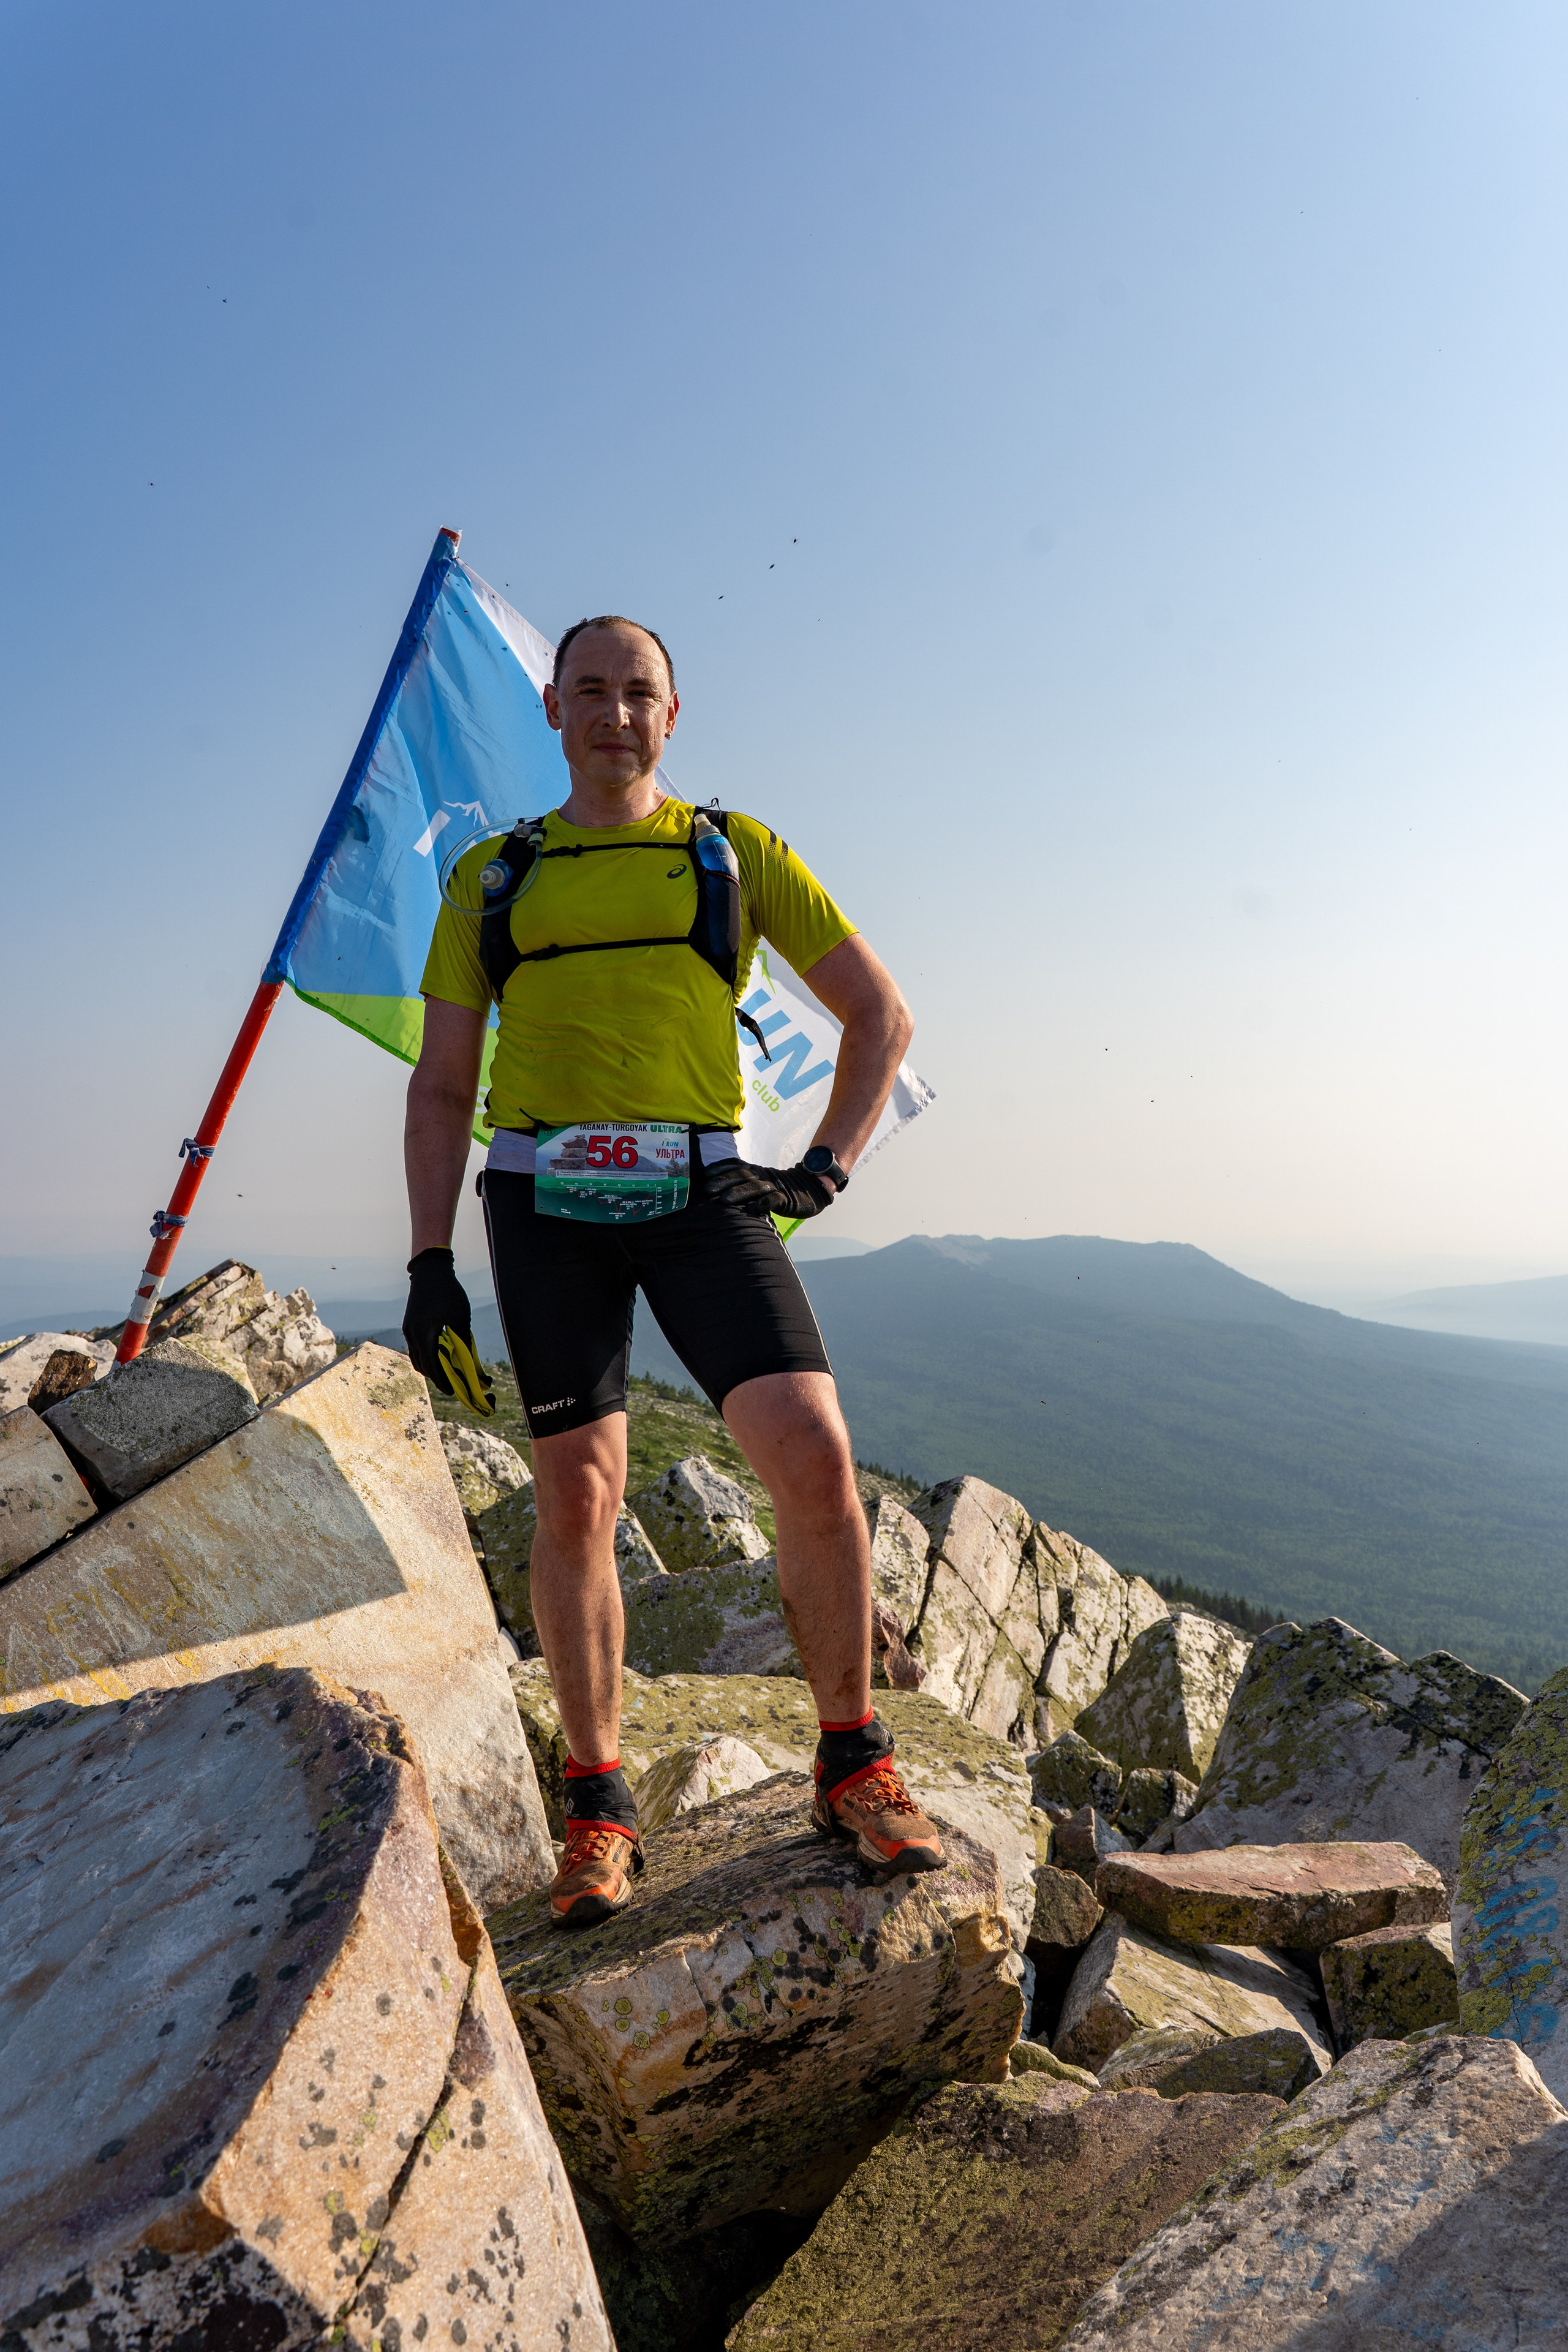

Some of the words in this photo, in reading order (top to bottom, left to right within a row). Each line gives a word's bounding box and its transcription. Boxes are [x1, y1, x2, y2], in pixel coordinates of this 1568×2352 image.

[736, 988, 835, 1101] UN
[752, 1079, 780, 1112] club
[579, 1123, 647, 1132] TAGANAY-TURGOYAK
[650, 1125, 683, 1134] ULTRA
[586, 1135, 639, 1169] 56
[655, 1148, 685, 1159] УЛЬТРА
[531, 1399, 565, 1414] CRAFT
